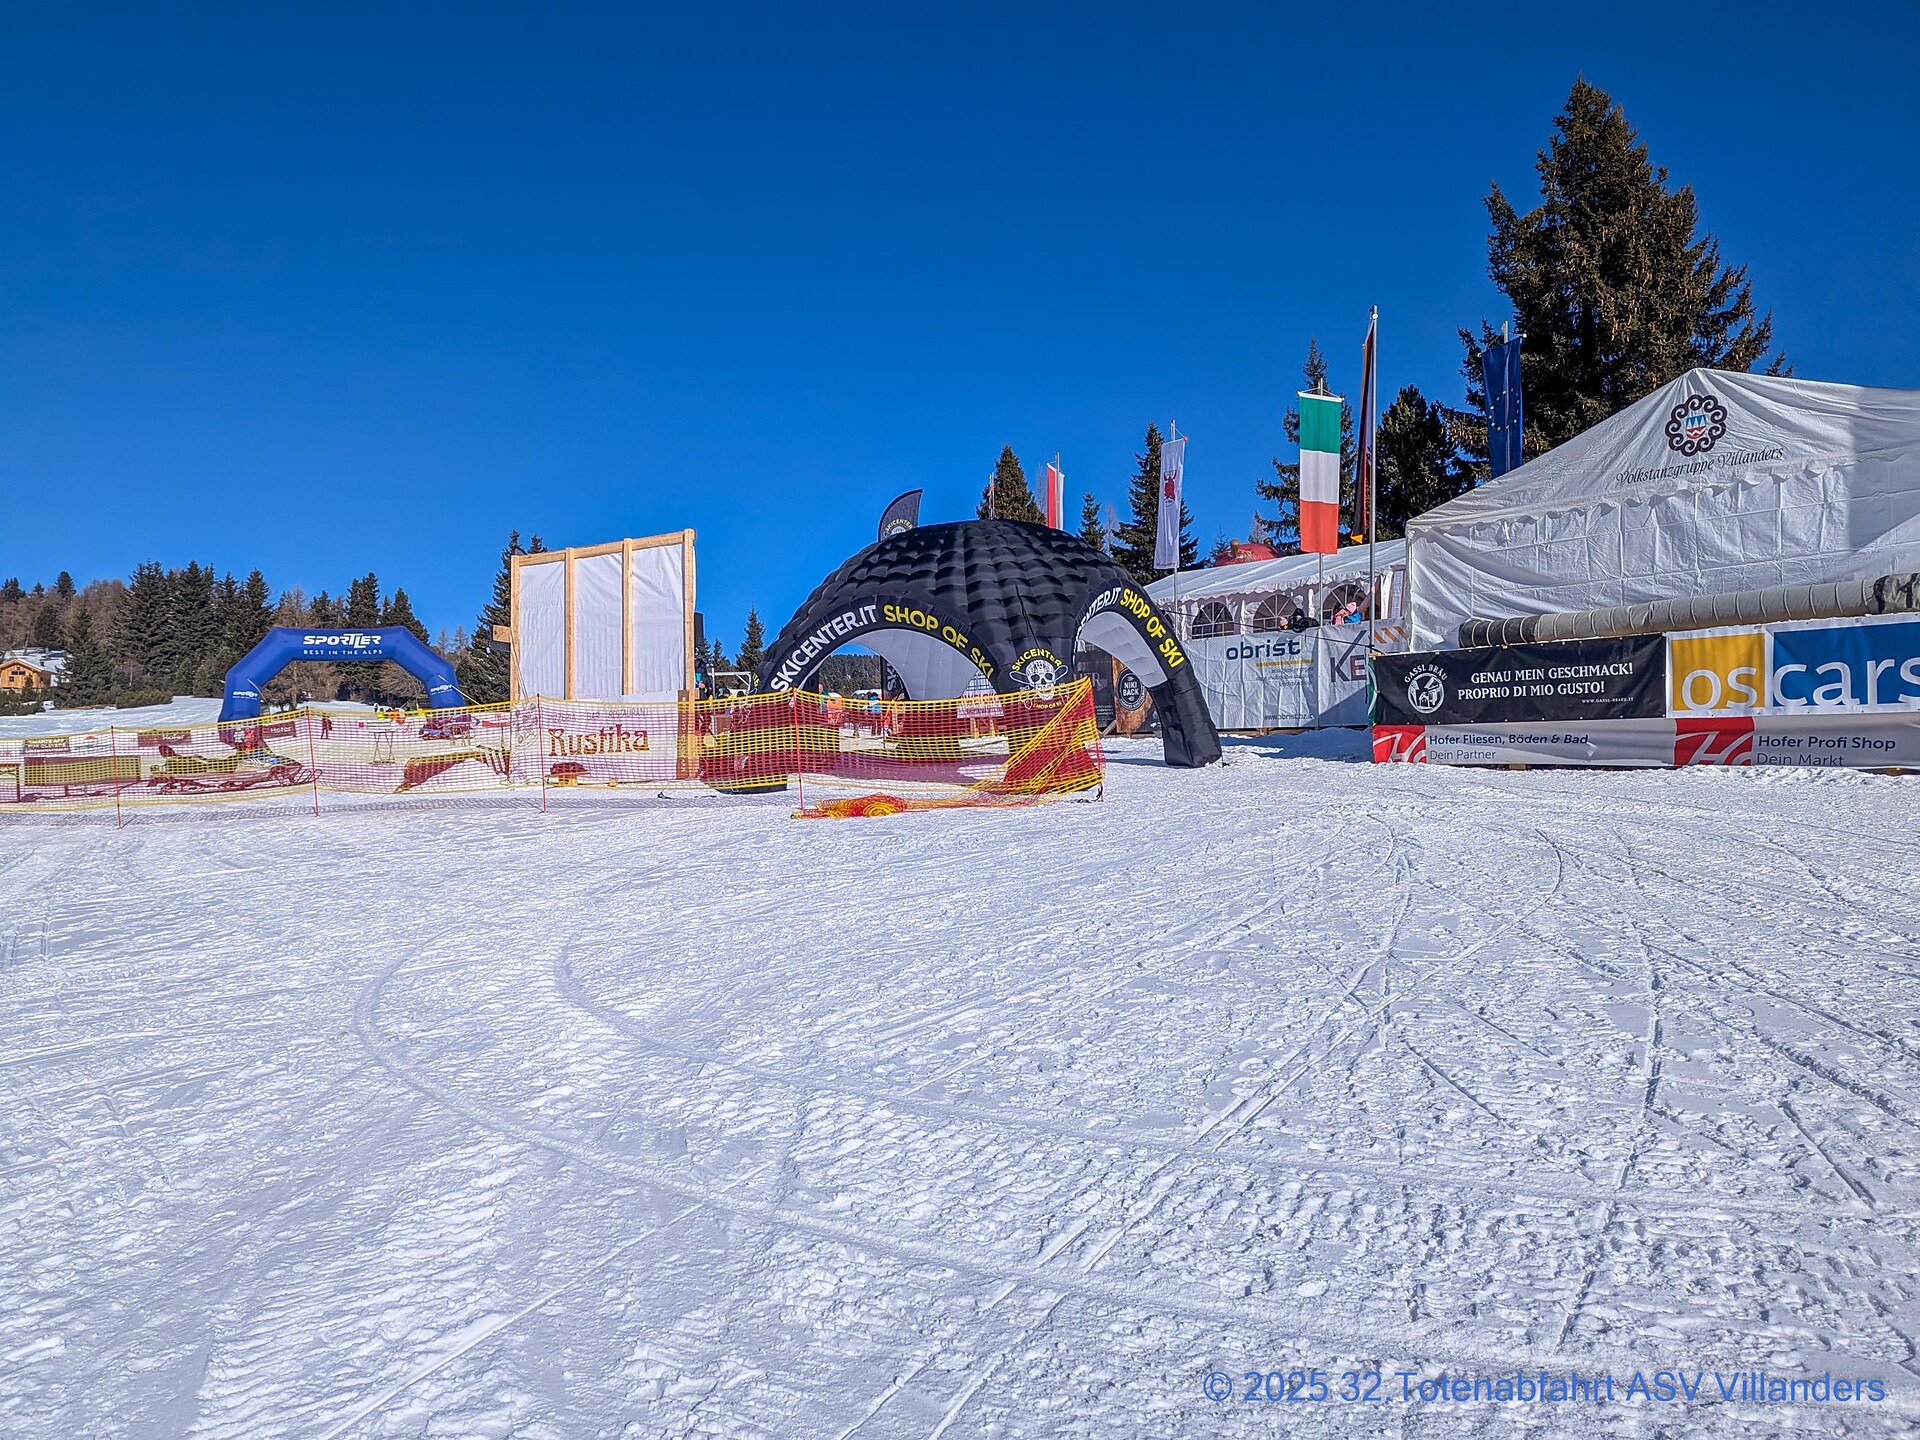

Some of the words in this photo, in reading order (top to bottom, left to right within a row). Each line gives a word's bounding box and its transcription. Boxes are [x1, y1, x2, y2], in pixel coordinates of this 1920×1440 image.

[1616, 459, 1714, 485] Volkstanzgruppe
[1717, 445, 1784, 469] Villanders
[1119, 588, 1151, 619] SHOP
[1146, 616, 1167, 638] OF
[1159, 637, 1185, 668] SKI
[303, 633, 382, 649] SPORTLER
[770, 604, 878, 692] SKICENTER.IT
[883, 604, 939, 631] SHOP
[942, 626, 969, 649] OF
[970, 647, 994, 679] SKI
[1226, 639, 1301, 660] obrist
[1012, 648, 1063, 671] SKICENTER
[1404, 664, 1427, 683] GASSL
[1428, 664, 1449, 681] BRÄU
[1471, 671, 1511, 684] GENAU
[1515, 669, 1545, 681] MEIN
[1548, 662, 1634, 678] GESCHMACK!
[1124, 681, 1138, 689] NIKI
[1457, 686, 1510, 700] PROPRIO
[1513, 685, 1527, 697] DI
[1530, 685, 1554, 696] MIO
[1557, 681, 1605, 695] GUSTO!
[548, 724, 649, 756] Rustika
[1429, 735, 1461, 745] Hofer
[1463, 734, 1506, 745] Fliesen,
[1508, 734, 1548, 744] Böden
[1551, 734, 1560, 744] &
[1563, 734, 1588, 744] Bad
[1758, 735, 1804, 748] Hofer
[1807, 736, 1848, 749] Profi
[1851, 736, 1896, 752] Shop
[1429, 750, 1454, 760] Dein
[1457, 749, 1496, 760] Partner
[1757, 752, 1792, 766] Dein
[1798, 753, 1845, 767] Markt
